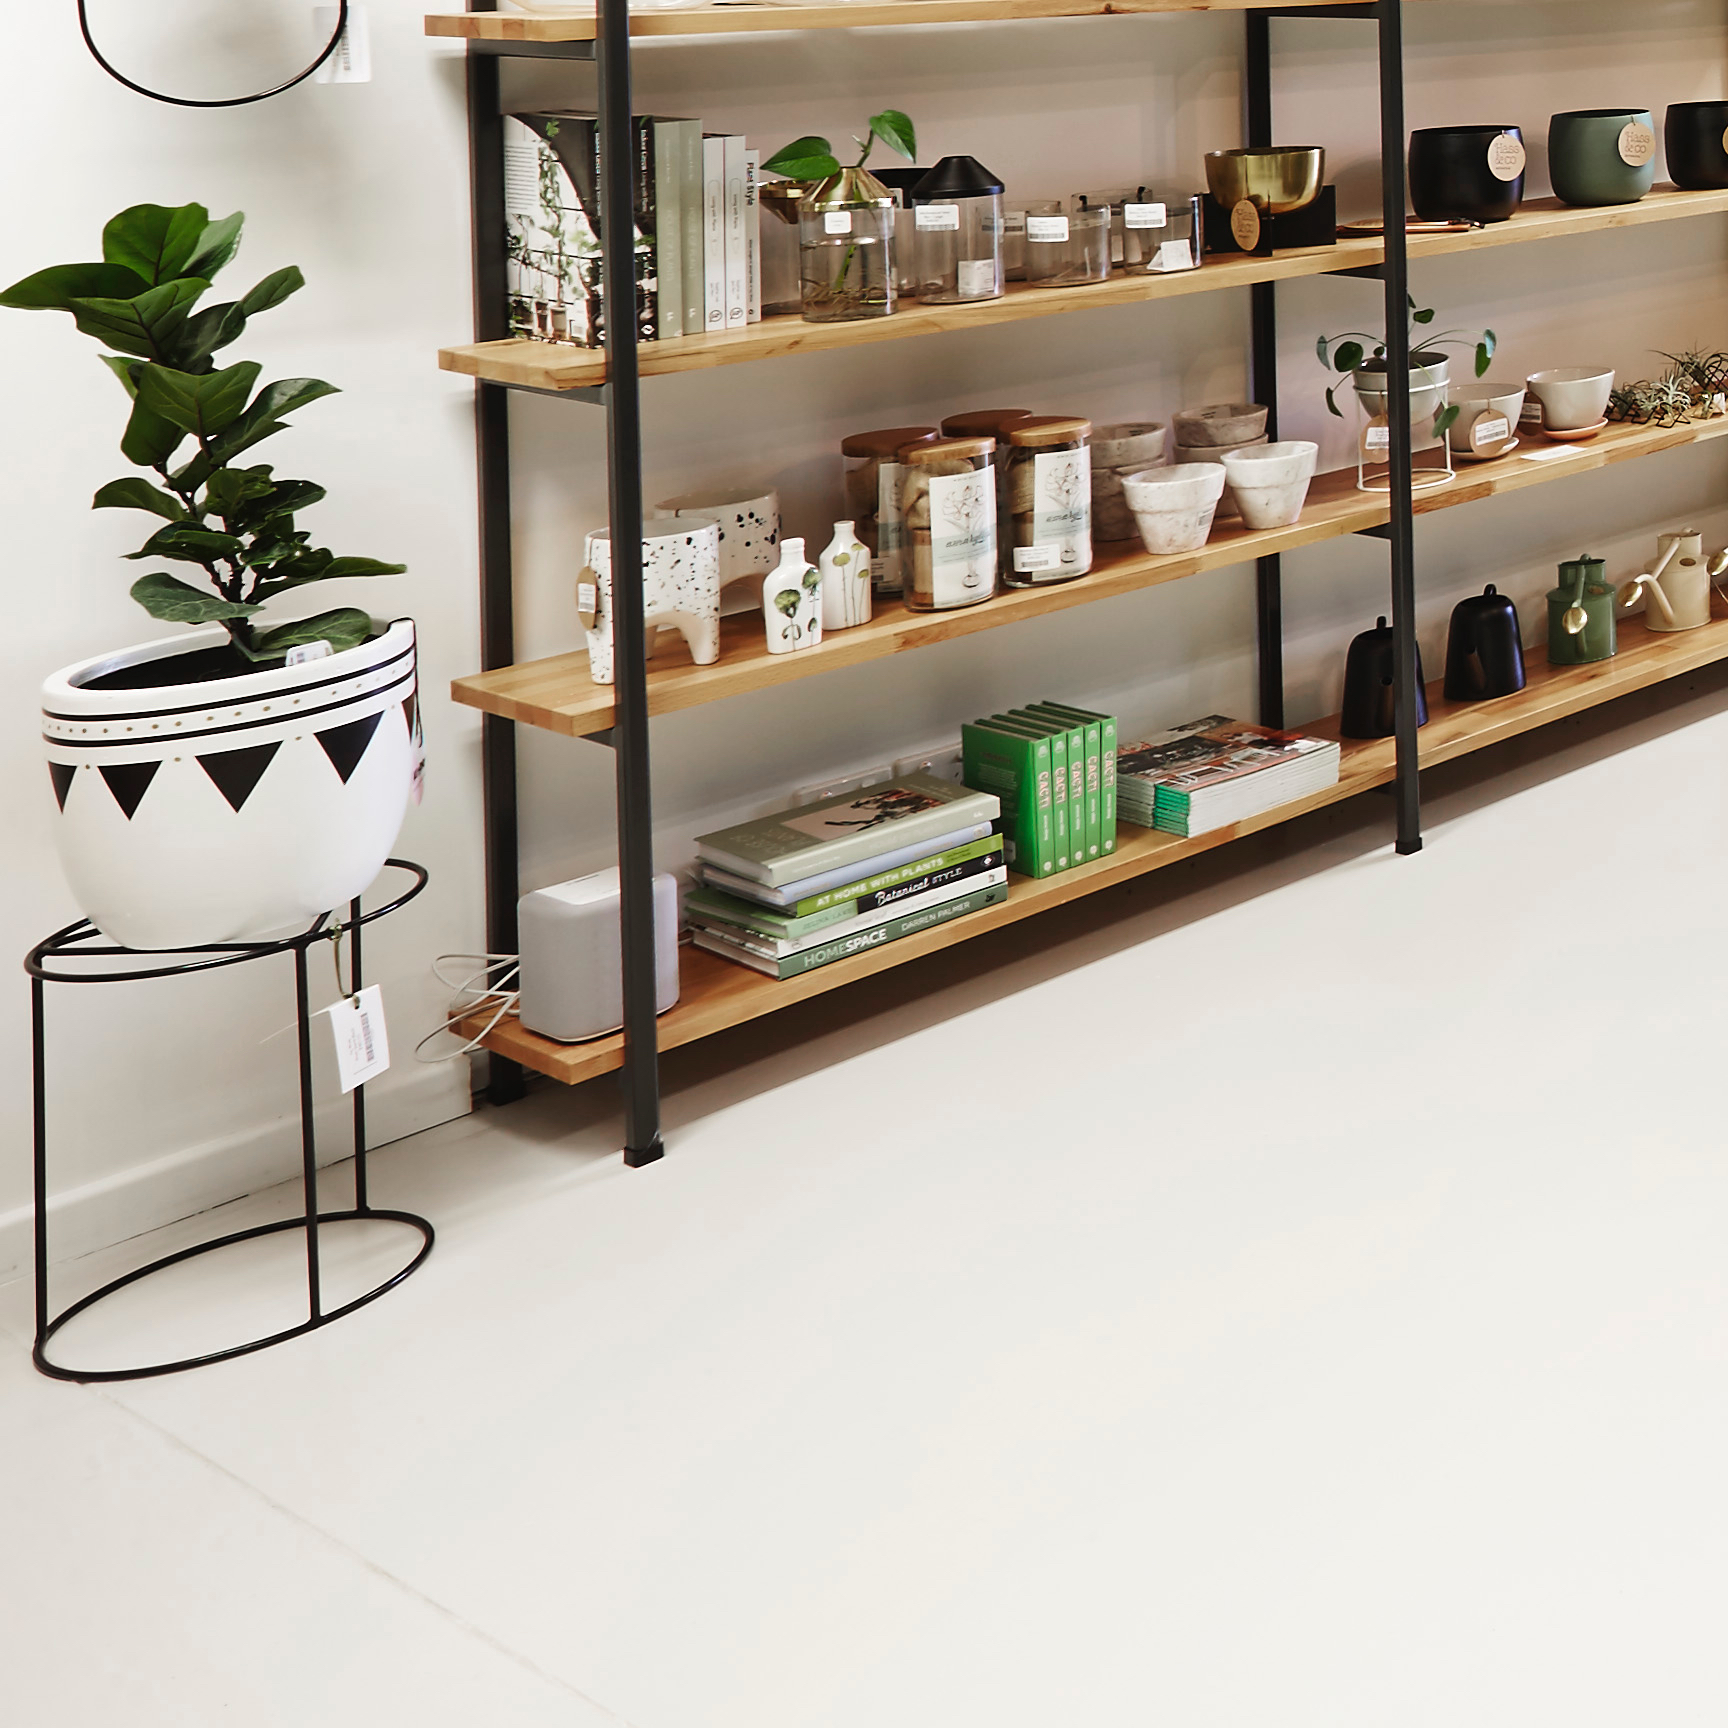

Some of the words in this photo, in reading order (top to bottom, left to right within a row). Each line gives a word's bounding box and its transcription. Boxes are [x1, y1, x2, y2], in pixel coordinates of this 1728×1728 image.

[1055, 767, 1066, 804] CACTI
[1071, 761, 1082, 799] CACTI
[1087, 756, 1098, 792] CACTI
[1104, 751, 1114, 788] CACTI
[1038, 771, 1050, 809] CACTI
[816, 894, 831, 907] AT
[832, 883, 868, 901] HOME
[870, 872, 899, 889] WITH
[902, 857, 944, 878] PLANTS
[874, 877, 930, 906] Botanical
[932, 867, 963, 884] STYLE
[937, 900, 971, 919] PALMER
